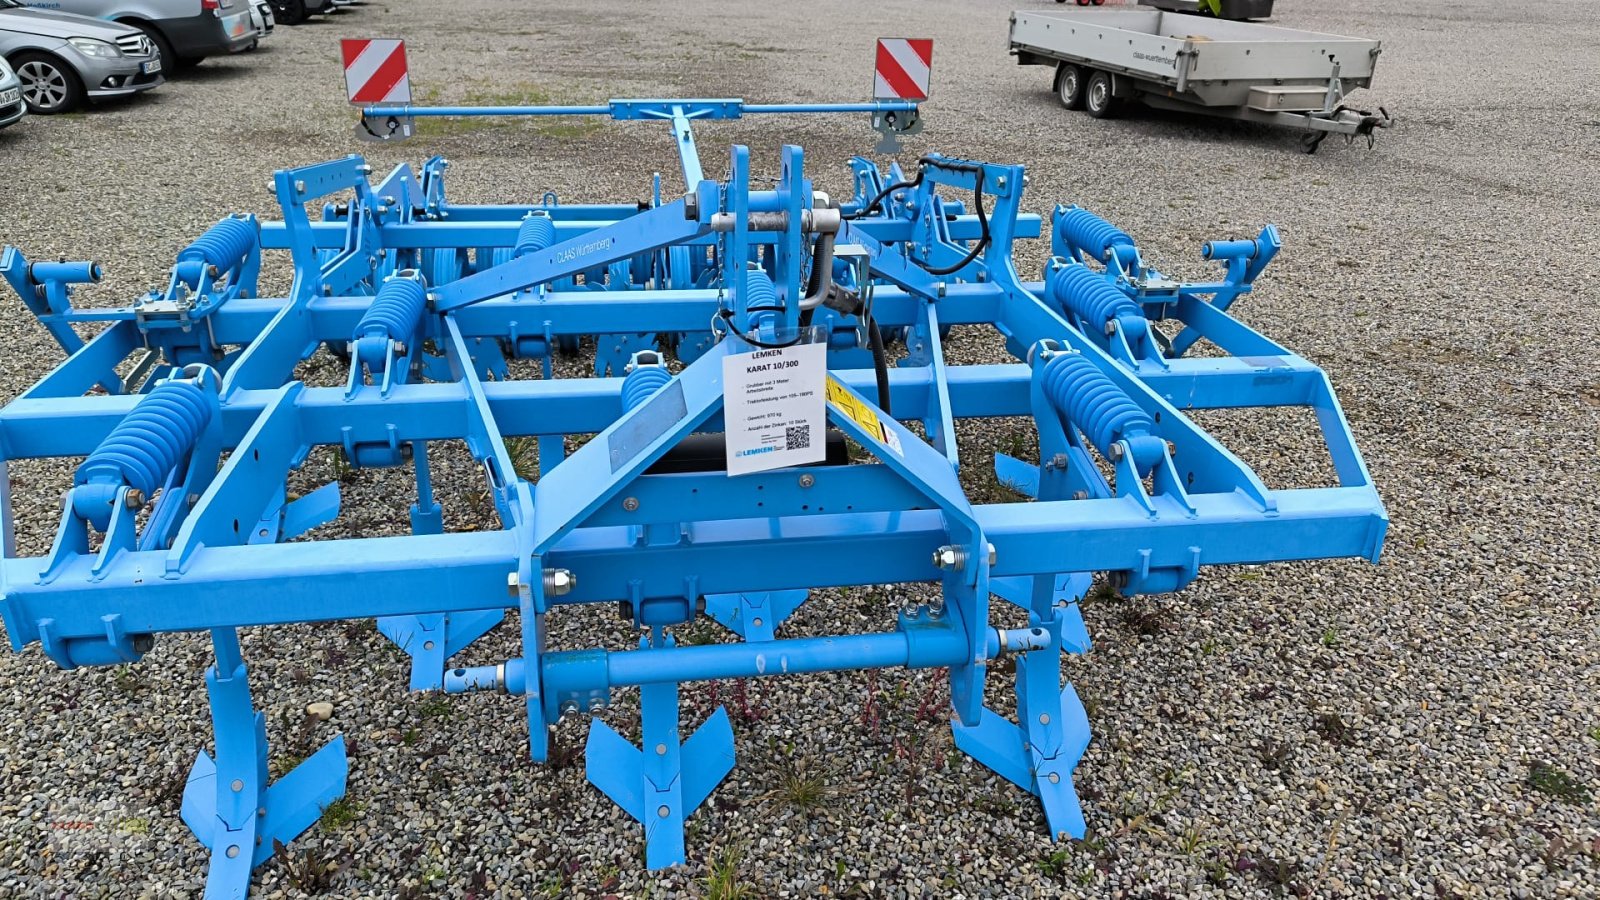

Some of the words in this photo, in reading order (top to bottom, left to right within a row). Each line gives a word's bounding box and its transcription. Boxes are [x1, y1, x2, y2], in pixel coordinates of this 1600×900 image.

[557, 247, 576, 263] CLAAS
[576, 238, 610, 256] Württemberg
[752, 349, 782, 359] LEMKEN
[746, 363, 771, 374] KARAT
[773, 360, 799, 370] 10/300
[743, 445, 773, 456] LEMKEN
